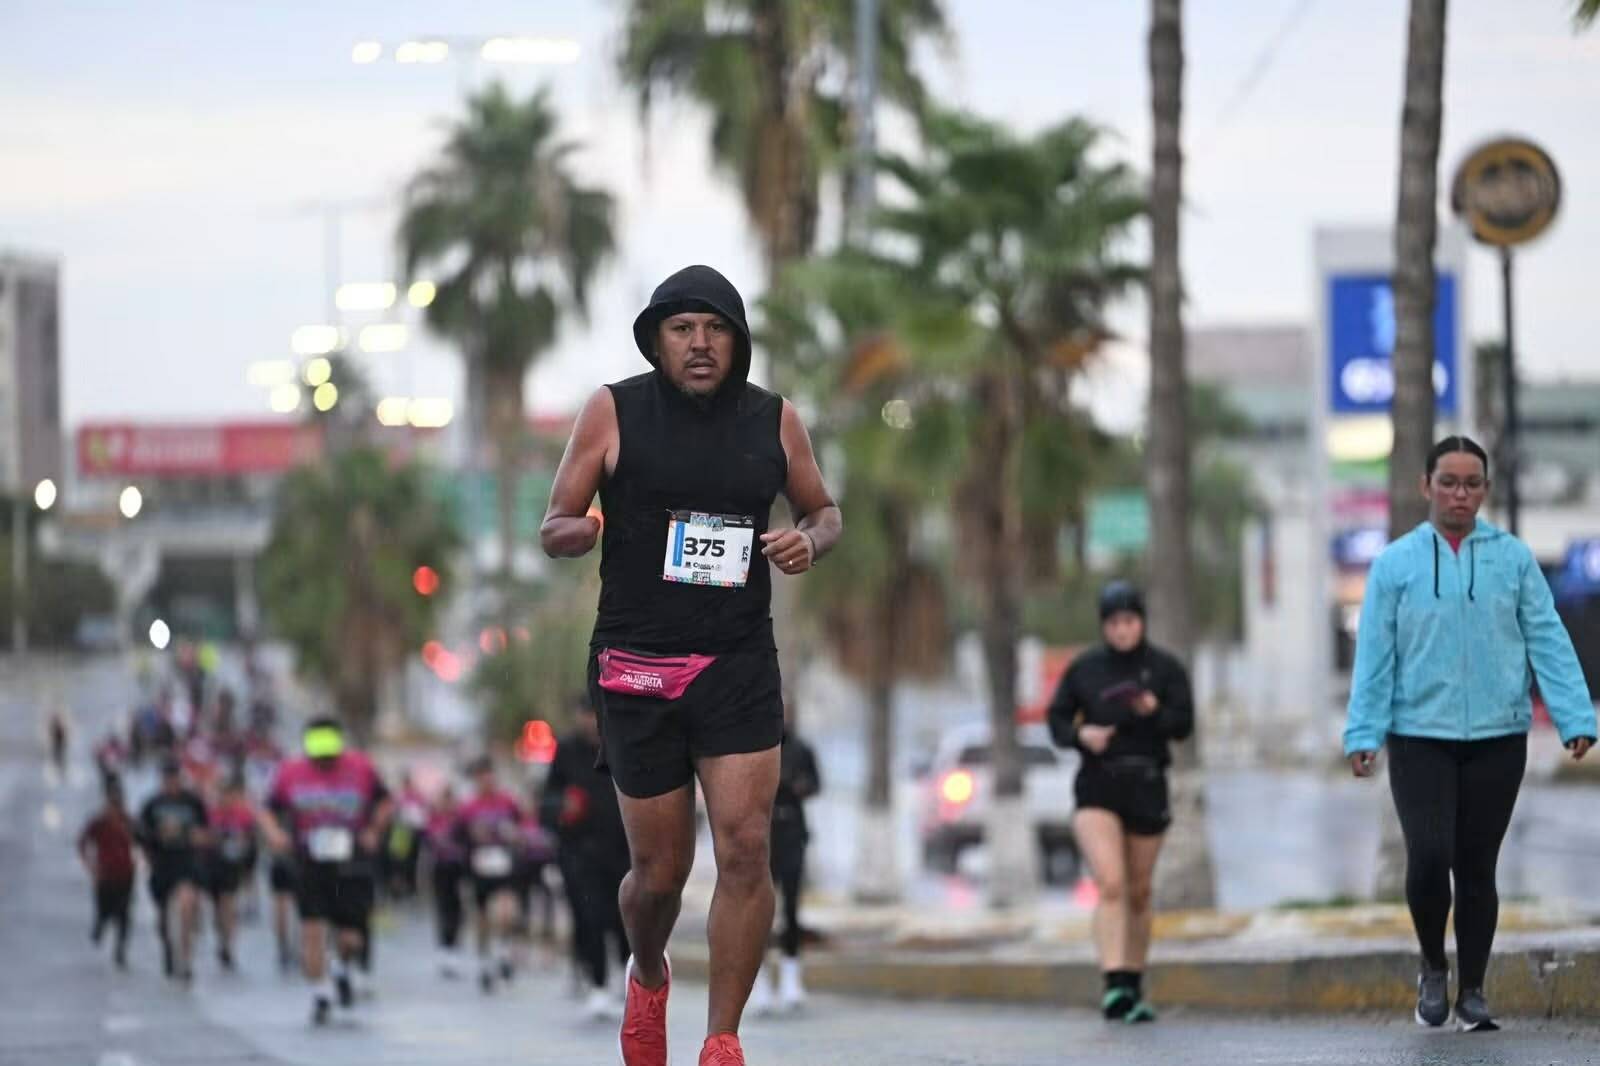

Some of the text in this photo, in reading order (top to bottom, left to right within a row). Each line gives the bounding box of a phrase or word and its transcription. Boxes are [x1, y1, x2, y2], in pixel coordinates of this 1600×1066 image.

[683, 536, 725, 557] 375
[741, 545, 749, 563] 375
[619, 673, 663, 688] CALAVERITA
